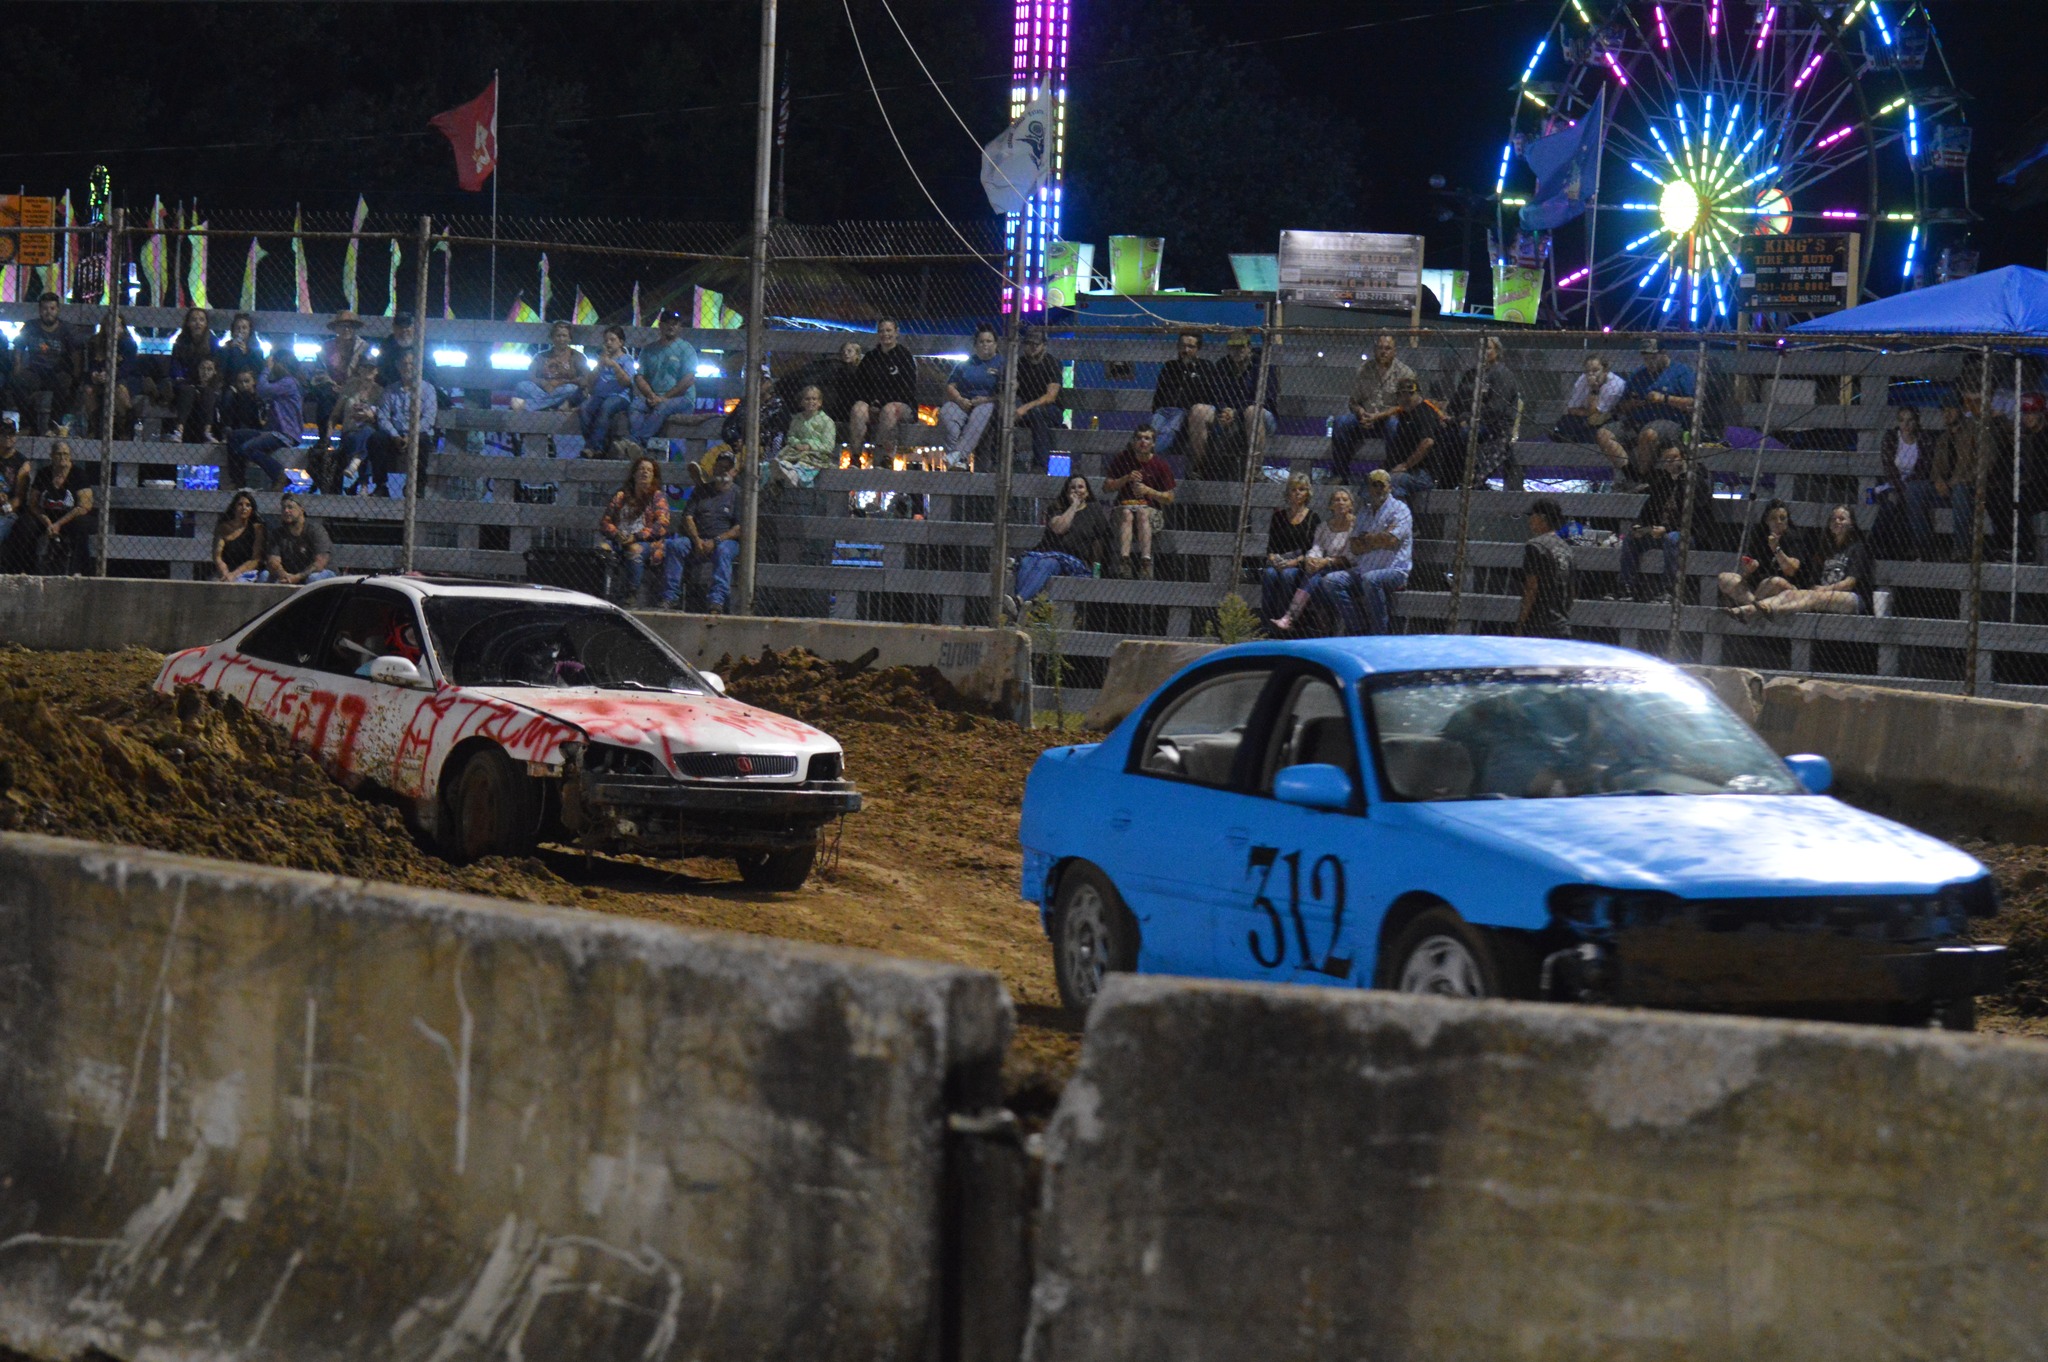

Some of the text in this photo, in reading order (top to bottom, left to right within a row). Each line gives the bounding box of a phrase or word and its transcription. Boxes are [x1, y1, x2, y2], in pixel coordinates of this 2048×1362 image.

[1755, 256, 1783, 264] TIRE
[1801, 255, 1834, 264] AUTO
[1764, 239, 1825, 253] KING'S
[452, 697, 582, 763] TRUMP
[1246, 846, 1353, 980] 312
